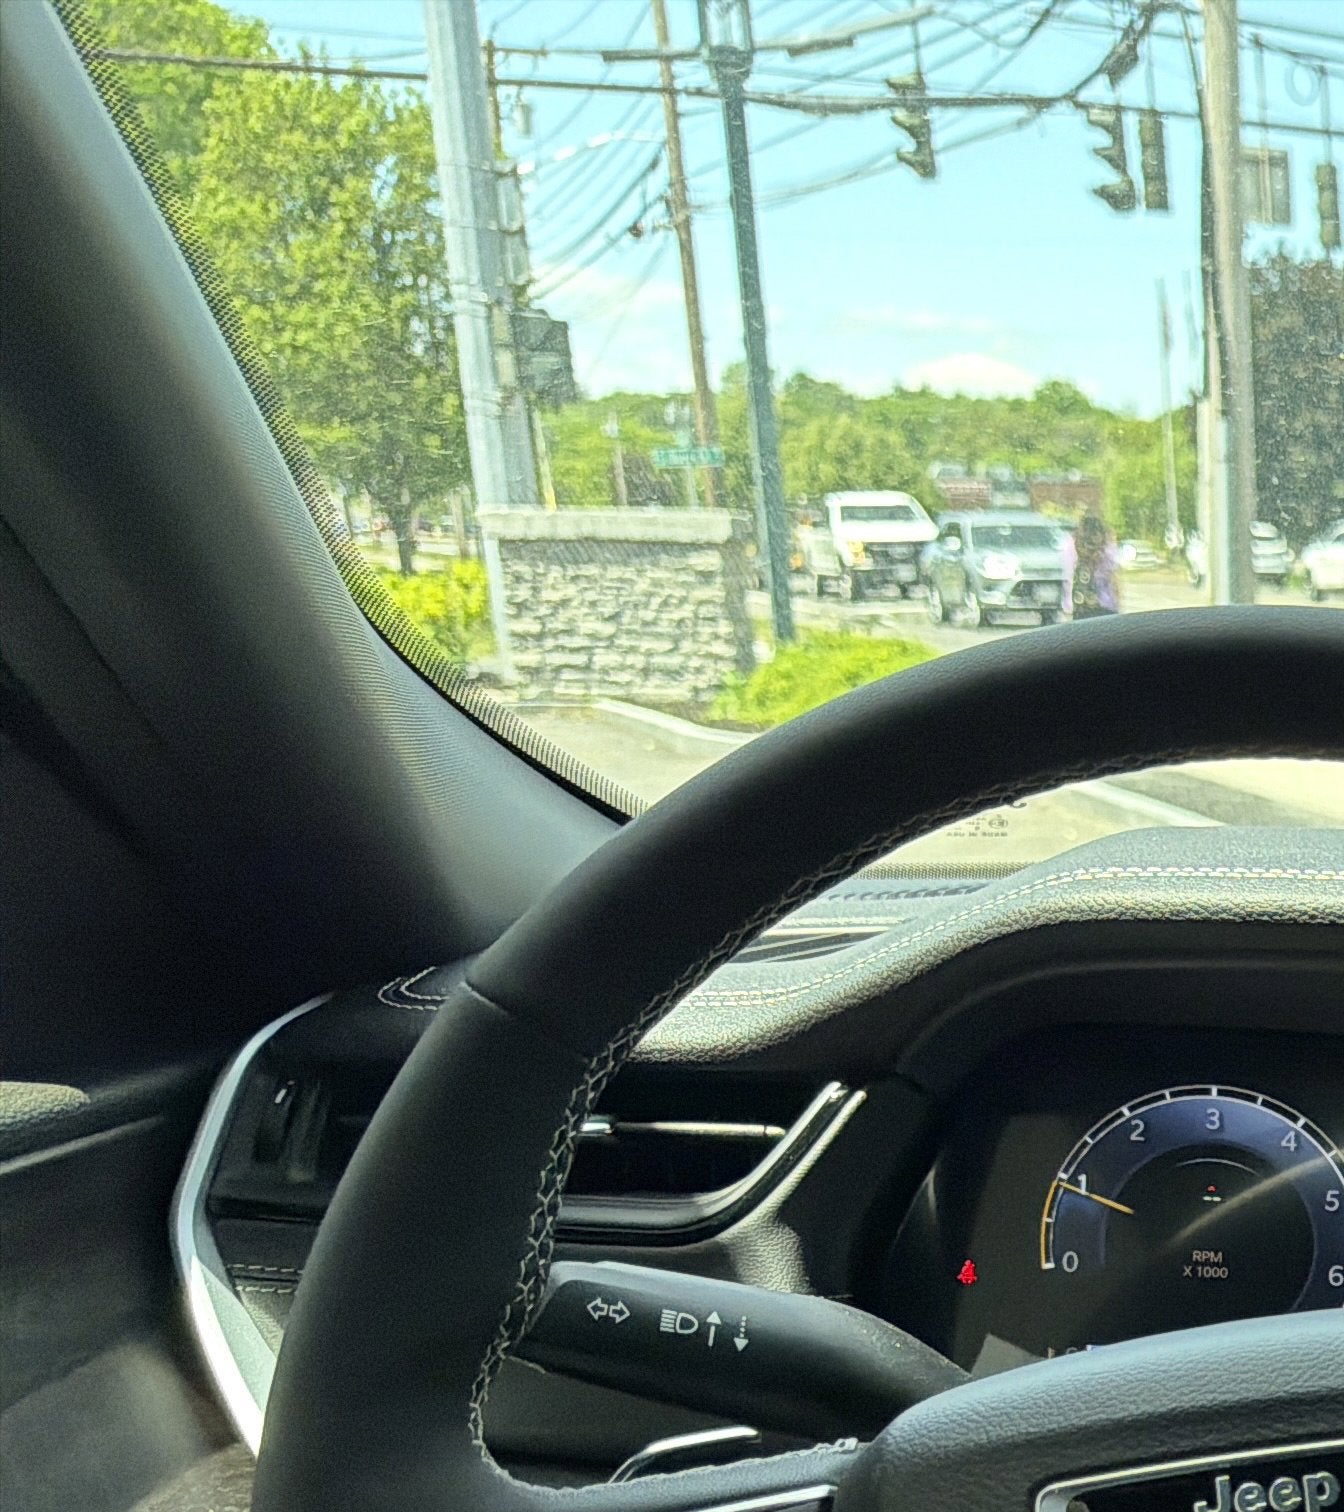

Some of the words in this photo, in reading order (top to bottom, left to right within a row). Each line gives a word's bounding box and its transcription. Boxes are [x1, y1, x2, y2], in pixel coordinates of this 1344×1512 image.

[1205, 1108, 1220, 1130] 3
[1129, 1120, 1145, 1142] 2
[1280, 1131, 1297, 1152] 4
[1077, 1174, 1087, 1195] 1
[1324, 1190, 1340, 1212] 5
[1062, 1251, 1079, 1273] 0
[1192, 1250, 1223, 1264] RPM
[1183, 1265, 1193, 1278] X
[1196, 1266, 1229, 1279] 1000
[1328, 1265, 1344, 1287] 6
